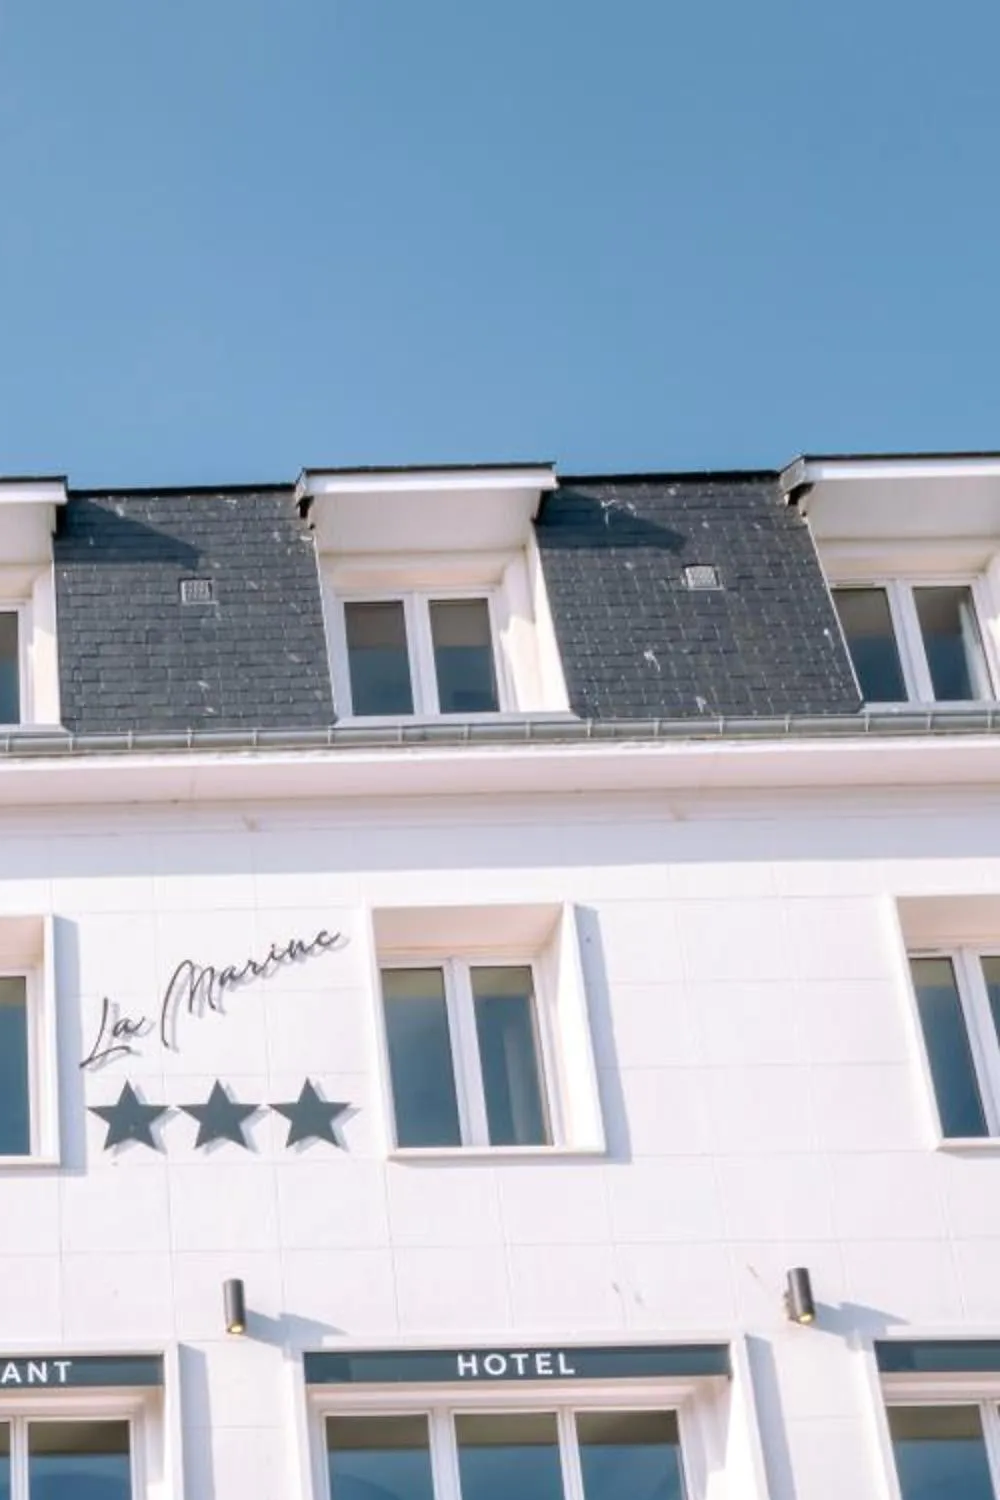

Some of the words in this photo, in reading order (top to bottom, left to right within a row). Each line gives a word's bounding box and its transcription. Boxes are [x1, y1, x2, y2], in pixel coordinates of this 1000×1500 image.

[79, 996, 147, 1068] La
[160, 929, 341, 1049] Marine
[456, 1352, 576, 1377] HOTEL
